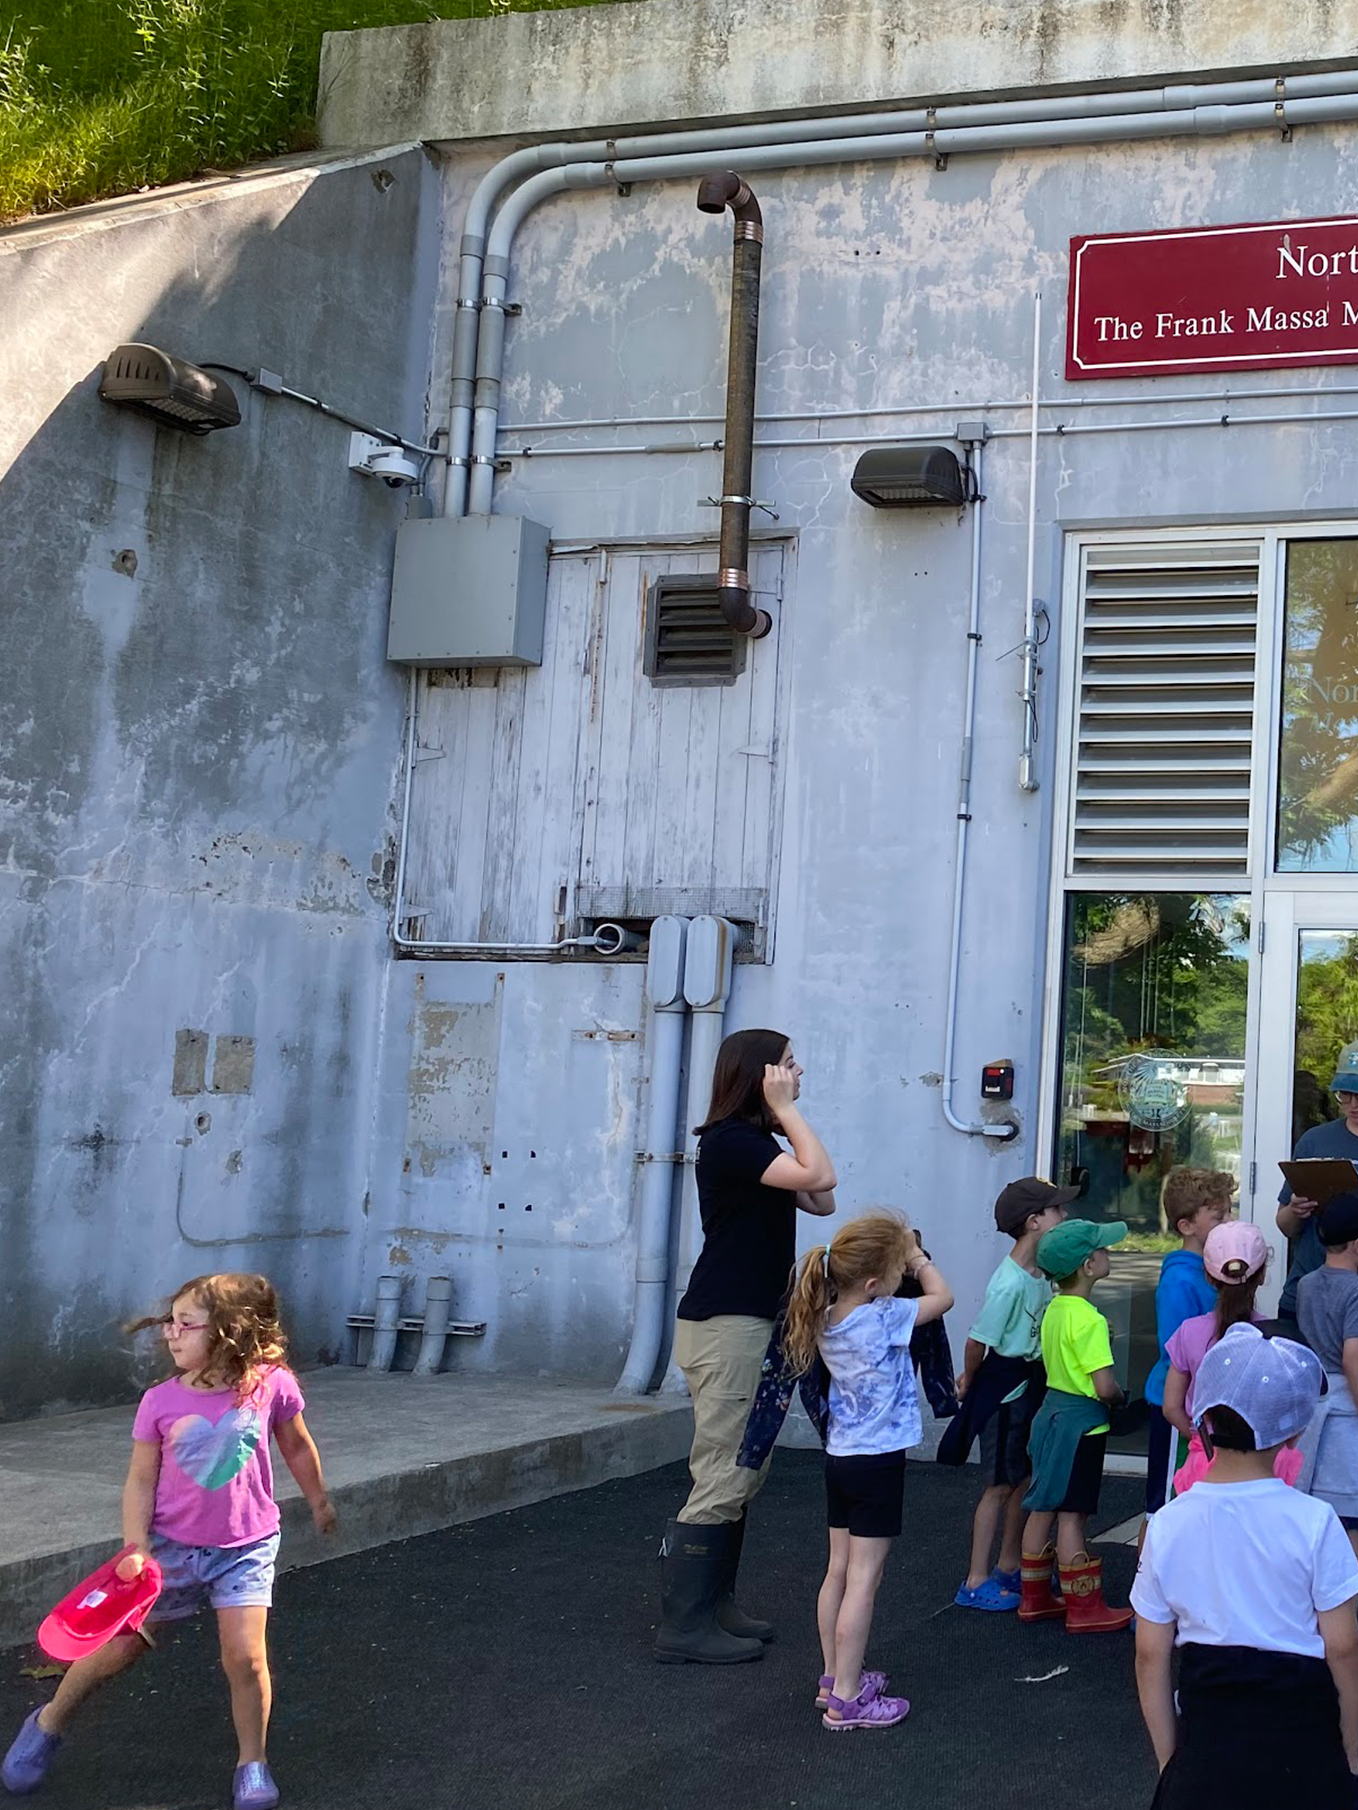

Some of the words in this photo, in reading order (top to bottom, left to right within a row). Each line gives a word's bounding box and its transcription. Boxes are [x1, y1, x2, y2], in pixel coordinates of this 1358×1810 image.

[1095, 317, 1143, 341] The
[1155, 310, 1235, 338] Frank
[1246, 305, 1330, 332] Massa
